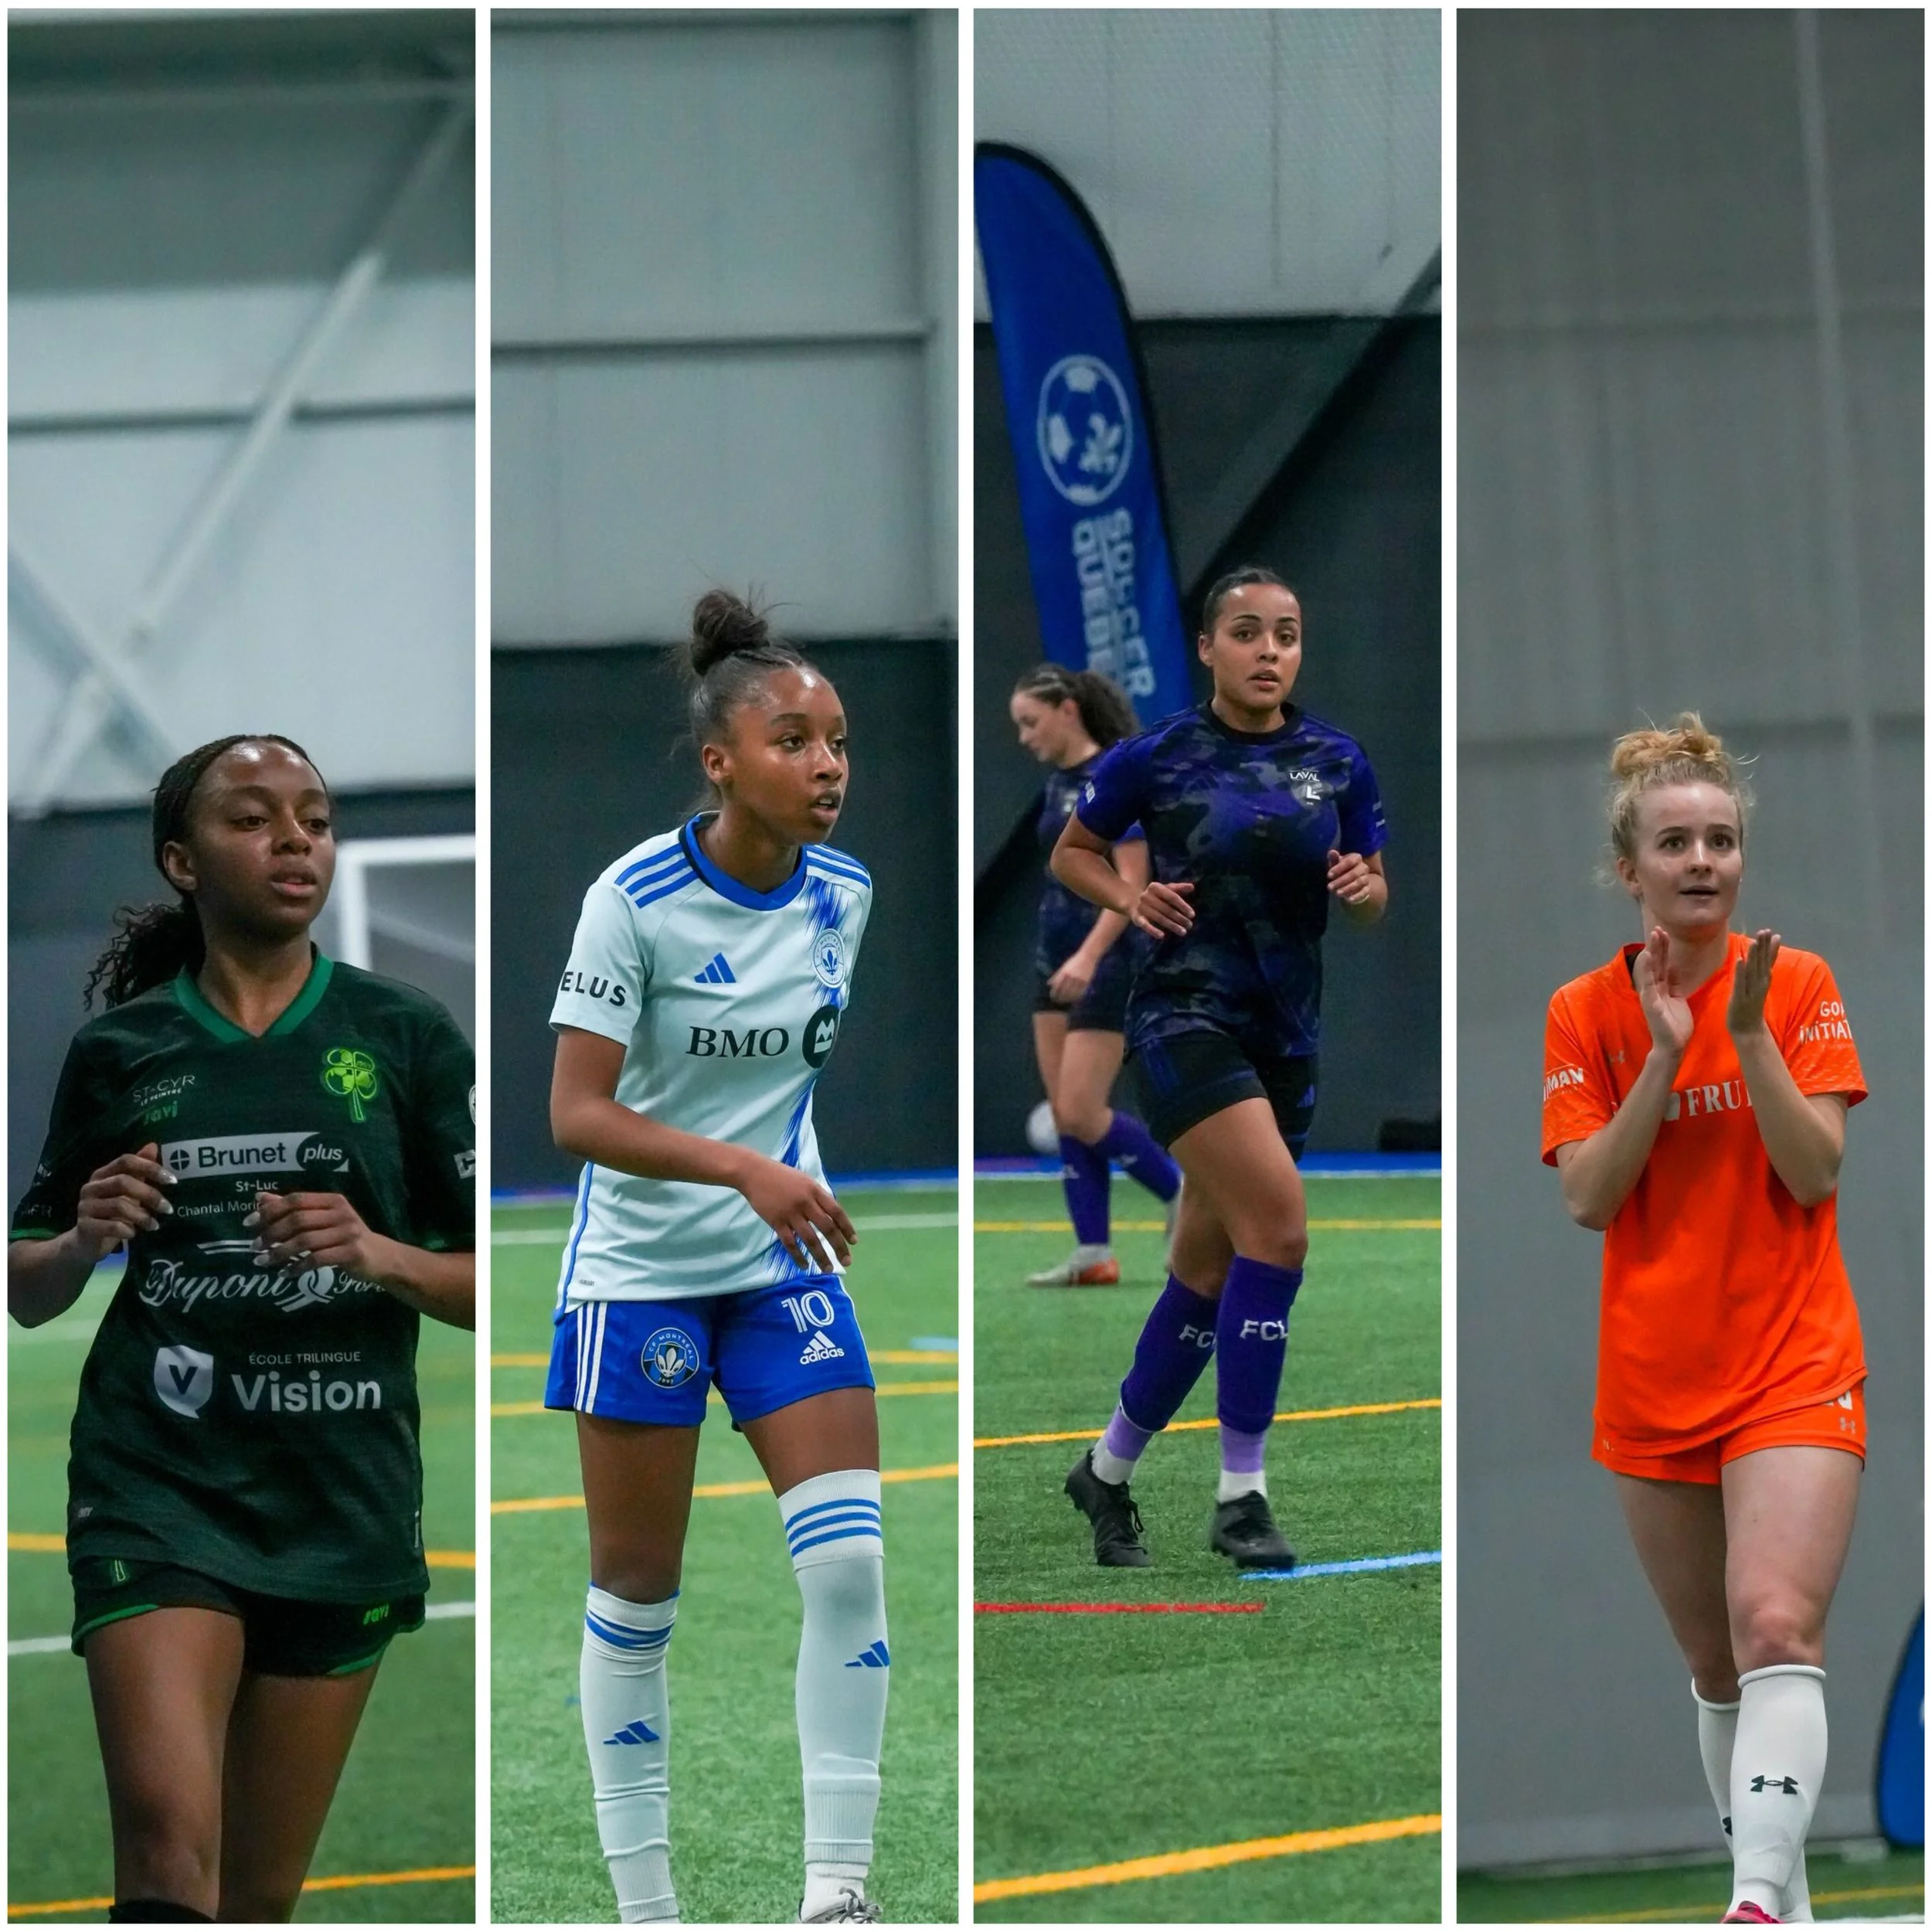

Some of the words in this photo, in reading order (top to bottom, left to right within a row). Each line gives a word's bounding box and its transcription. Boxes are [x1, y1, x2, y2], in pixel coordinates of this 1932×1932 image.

[1111, 507, 1156, 697] SOCCER
[1289, 770, 1320, 782] LAVAL
[560, 971, 627, 1006] ELUS
[685, 1026, 789, 1058] BMO
[198, 1142, 287, 1168] Brunet
[303, 1143, 344, 1163] plus
[235, 1179, 279, 1192] St-Luc
[177, 1204, 224, 1219] Chantal
[781, 1290, 835, 1334] 10
[1179, 1323, 1216, 1349] FC
[248, 1352, 292, 1366] ÉCOLE
[294, 1351, 362, 1365] TRILINGUE
[799, 1348, 845, 1366] adidas
[168, 1364, 199, 1396] V
[230, 1369, 382, 1412] Vision
